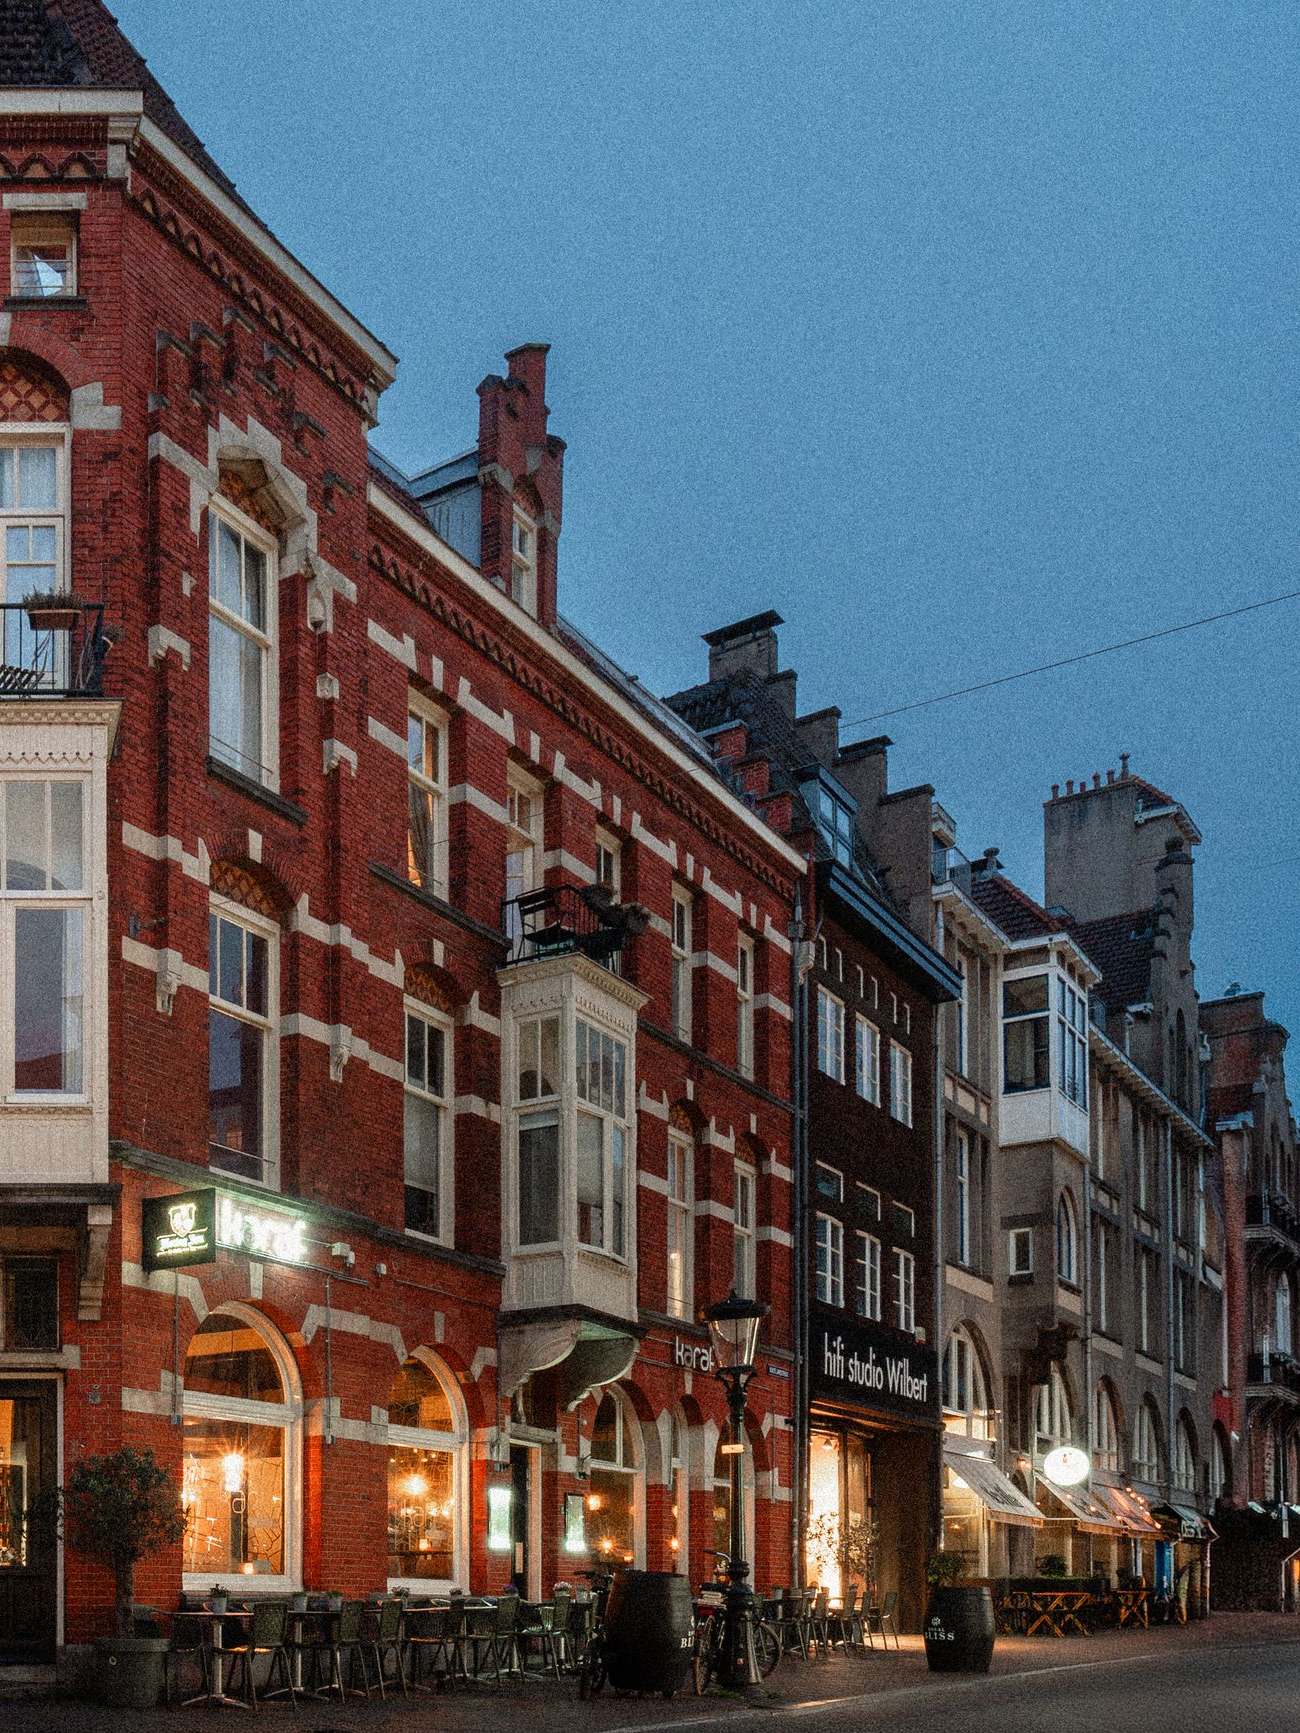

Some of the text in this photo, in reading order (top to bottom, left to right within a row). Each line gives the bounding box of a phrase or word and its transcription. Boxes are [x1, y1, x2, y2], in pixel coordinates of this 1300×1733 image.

[221, 1199, 308, 1262] karaf
[675, 1335, 715, 1372] karaf
[824, 1332, 928, 1402] hifi studio Wilbert
